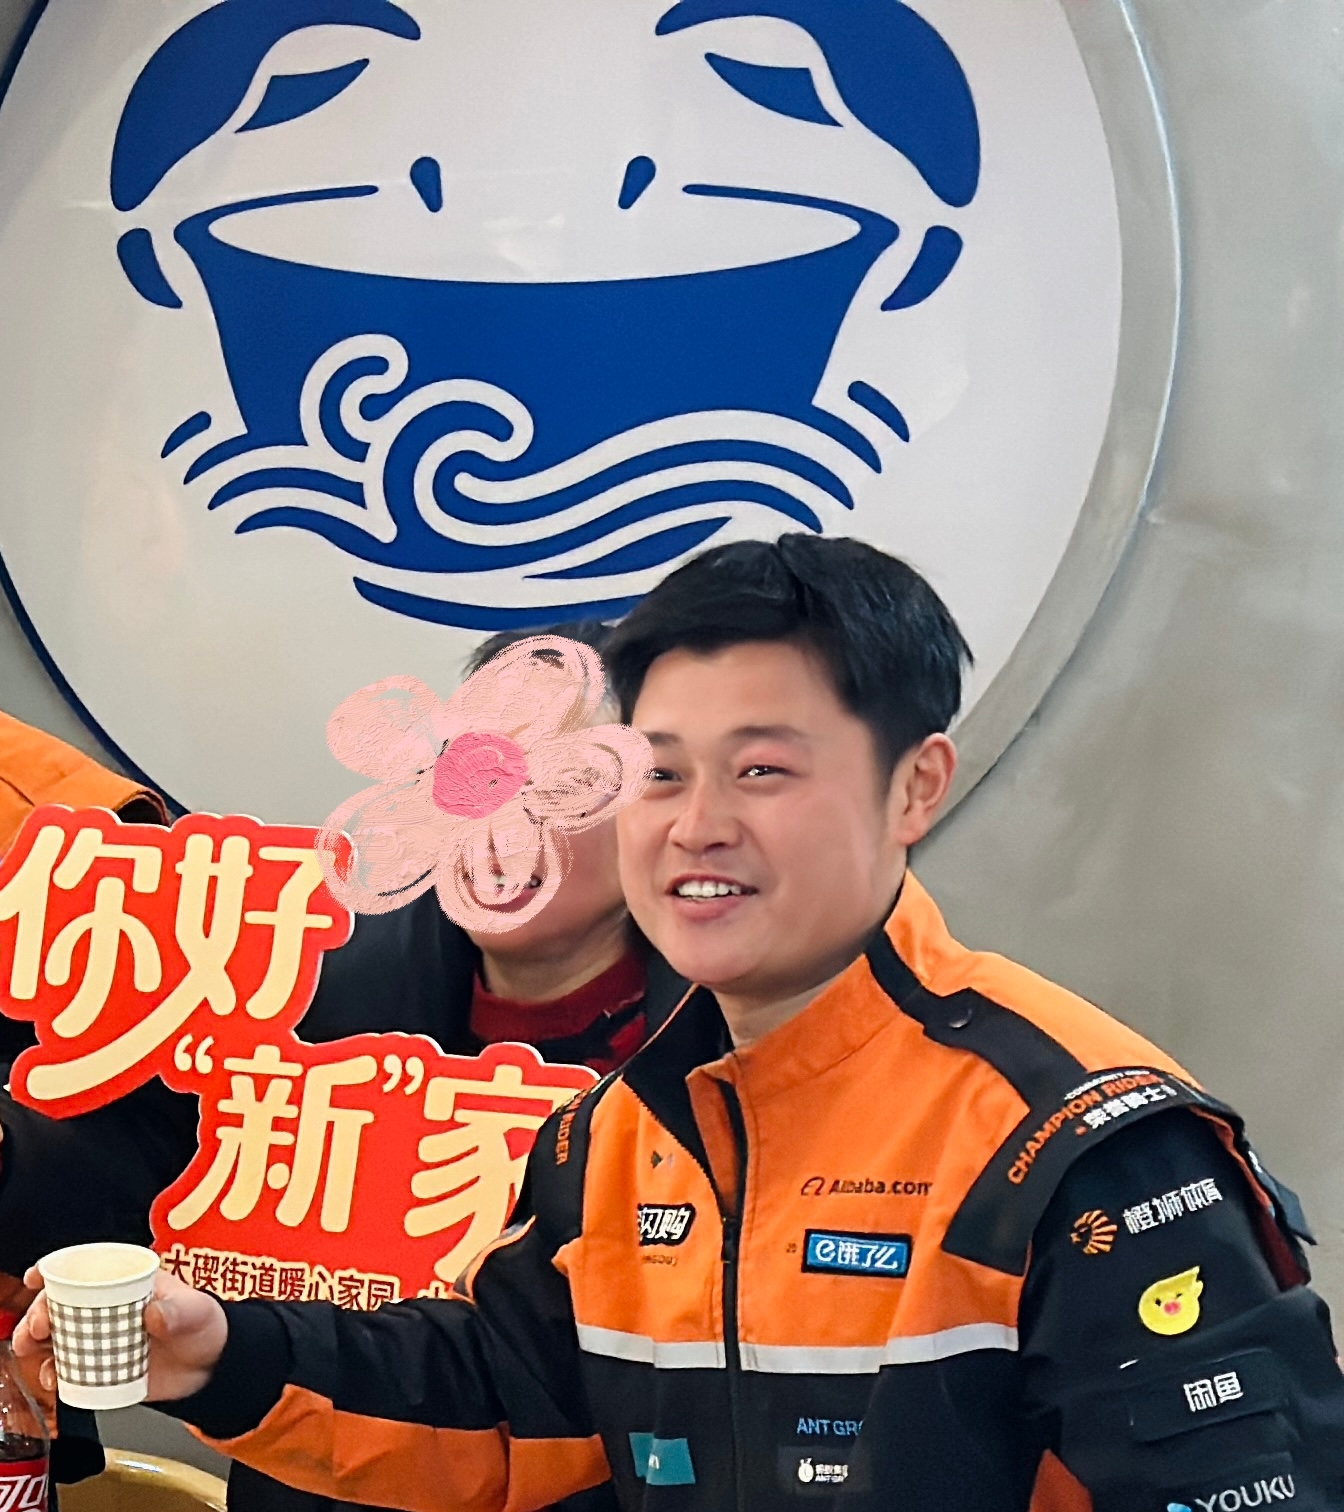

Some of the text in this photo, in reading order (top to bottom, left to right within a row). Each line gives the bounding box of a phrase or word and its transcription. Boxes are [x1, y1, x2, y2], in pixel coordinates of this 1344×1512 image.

[1007, 1089, 1103, 1185] CHAMPION
[1122, 1178, 1224, 1235] 橙狮体育
[796, 1416, 831, 1436] ANT
